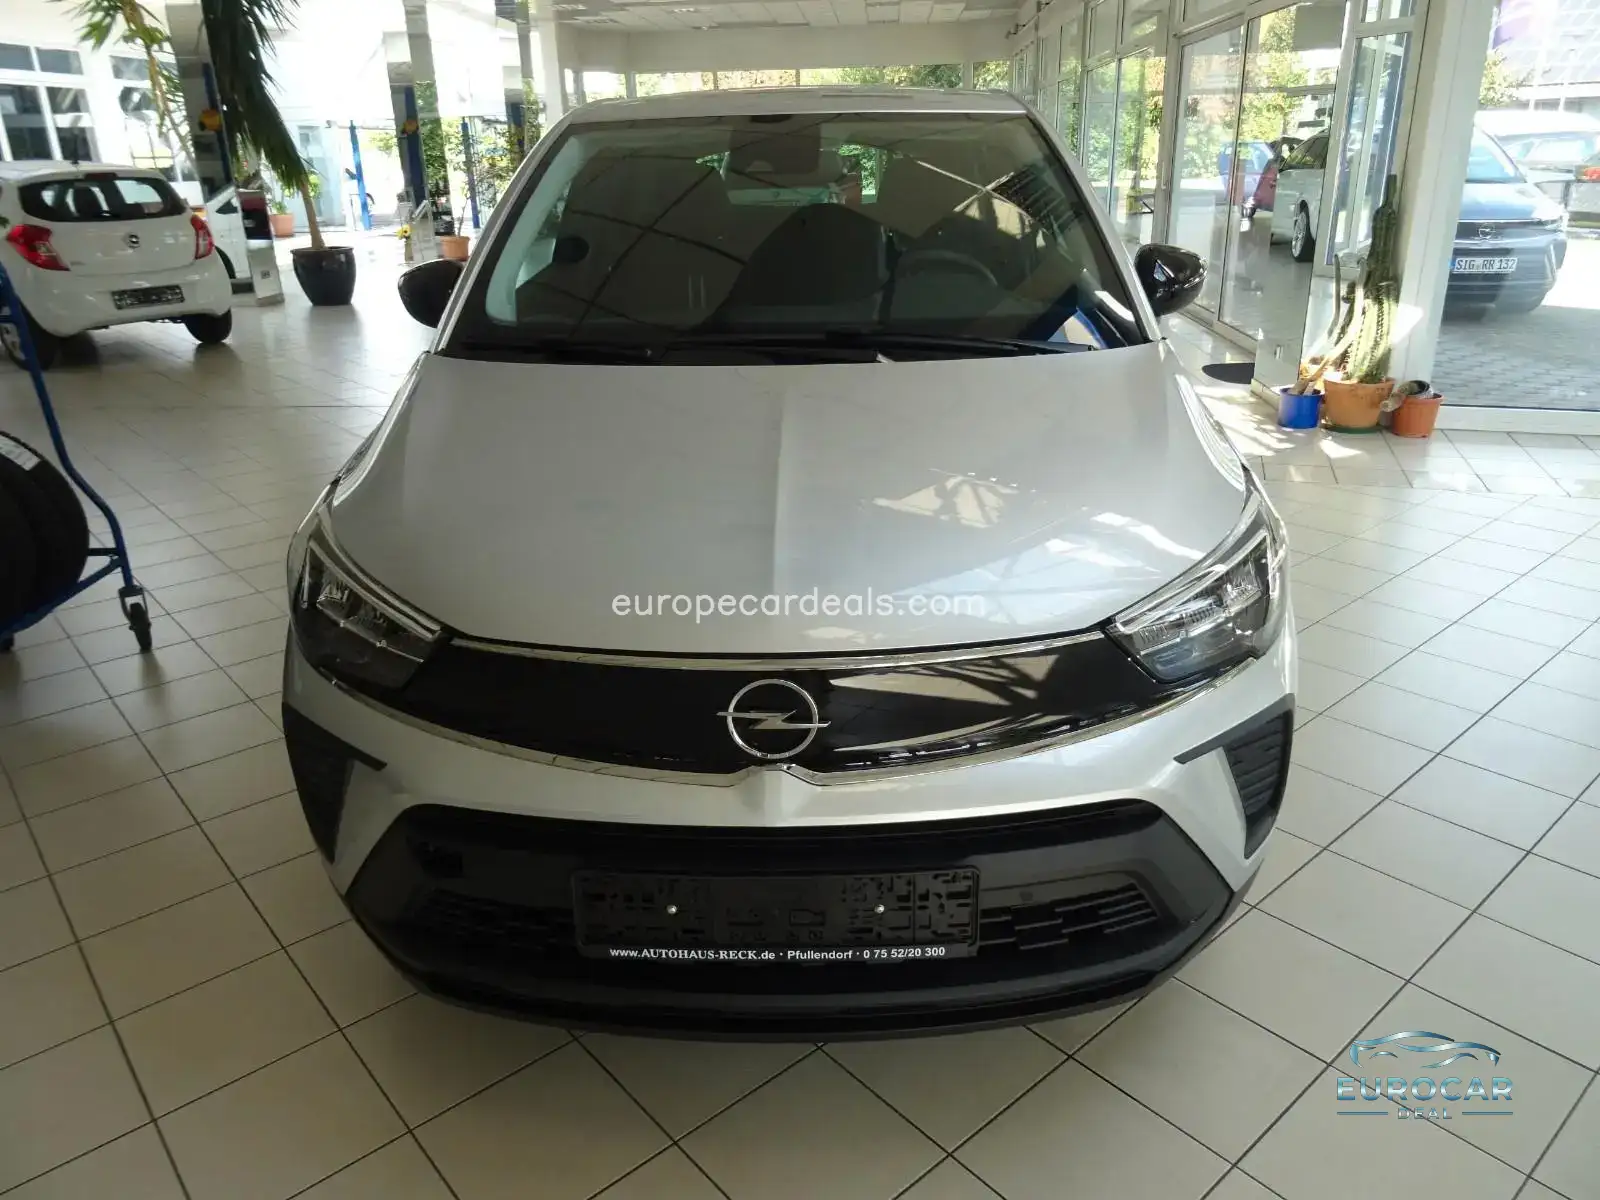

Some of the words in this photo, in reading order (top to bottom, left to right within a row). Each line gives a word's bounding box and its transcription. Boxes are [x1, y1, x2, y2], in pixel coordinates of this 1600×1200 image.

[1456, 259, 1476, 271] SIG
[1482, 259, 1495, 270] RR
[1497, 258, 1516, 270] 132
[609, 948, 776, 960] www.AUTOHAUS-RECK.de
[787, 950, 853, 960] Pfullendorf
[863, 949, 870, 959] 0
[874, 949, 888, 959] 75
[891, 947, 922, 958] 52/20
[925, 946, 946, 957] 300
